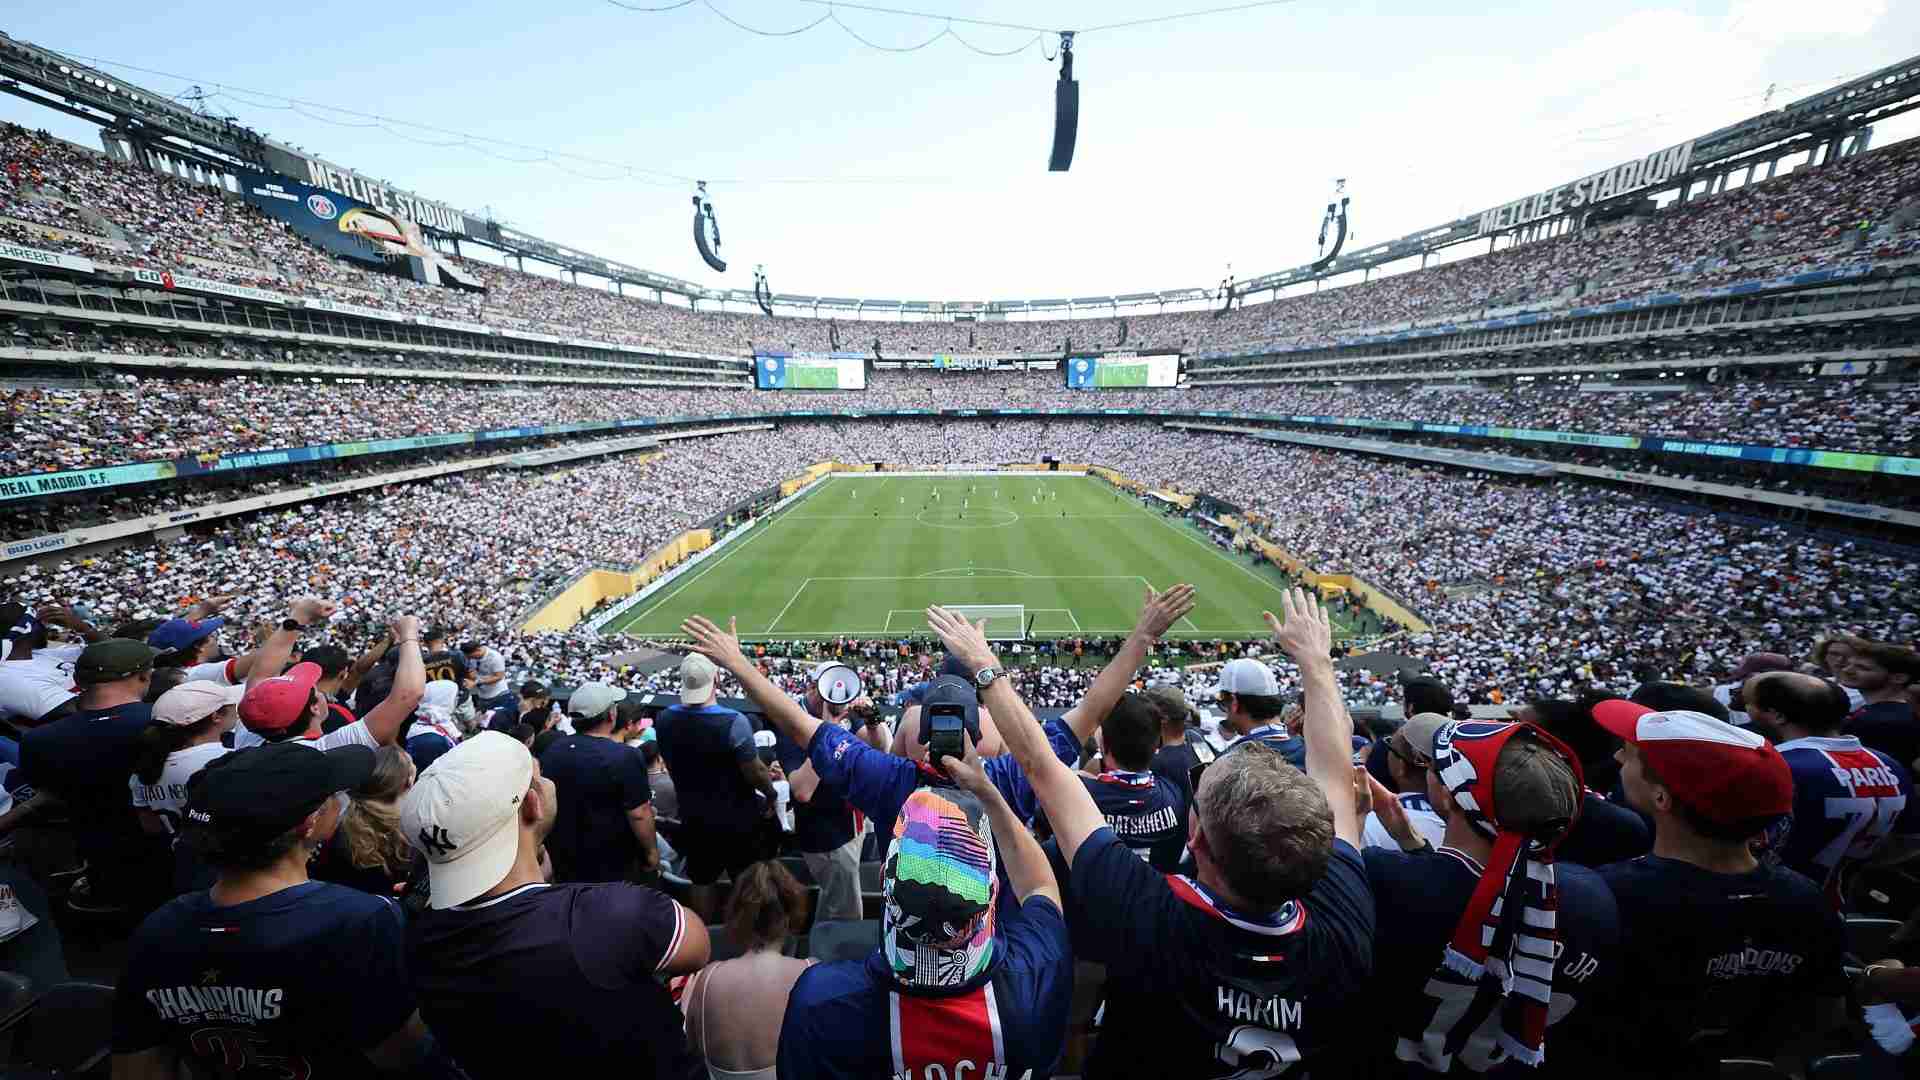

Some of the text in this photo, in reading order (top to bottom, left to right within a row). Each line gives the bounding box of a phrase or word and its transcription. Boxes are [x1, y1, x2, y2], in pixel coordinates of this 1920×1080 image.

[307, 160, 466, 236] METLIFE STADIUM
[1478, 141, 1695, 235] METLIFE STADIUM
[0, 245, 62, 264] HREBET
[0, 472, 110, 496] REAL MADRID C.F.
[8, 537, 65, 554] BUD LIGHT
[1831, 767, 1900, 787] PARIS
[1562, 952, 1599, 984] JR
[145, 984, 284, 1021] CHAMPIONS
[1216, 985, 1308, 1030] HAKIM
